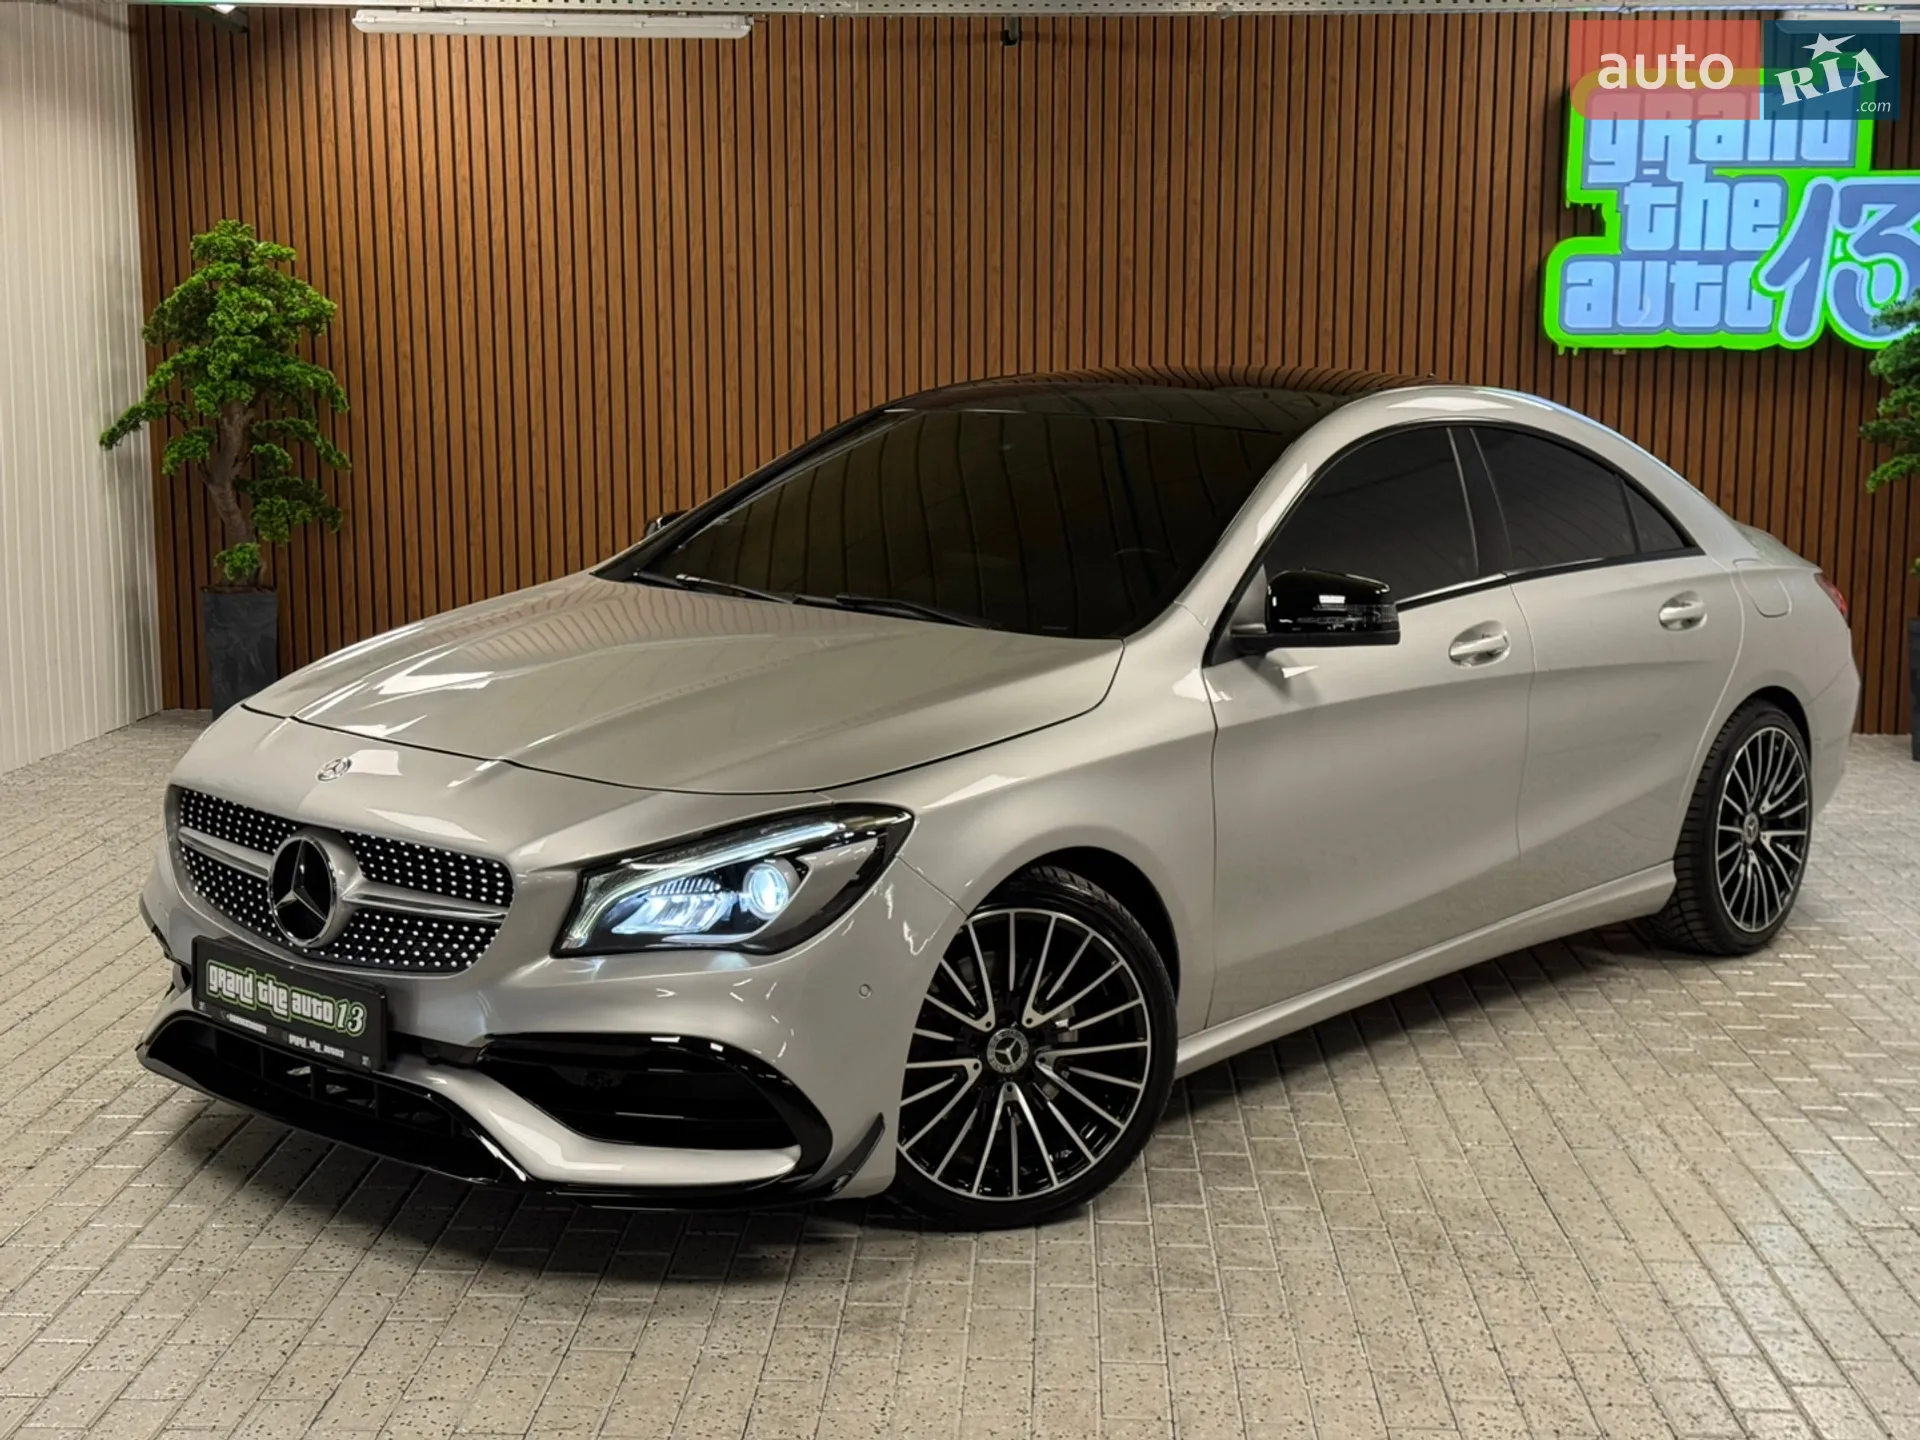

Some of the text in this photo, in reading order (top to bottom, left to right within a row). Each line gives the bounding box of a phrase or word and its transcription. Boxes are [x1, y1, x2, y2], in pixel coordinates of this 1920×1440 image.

[1624, 166, 1784, 252] the
[1564, 260, 1774, 328] auto
[208, 963, 366, 1034] grand the auto 13
